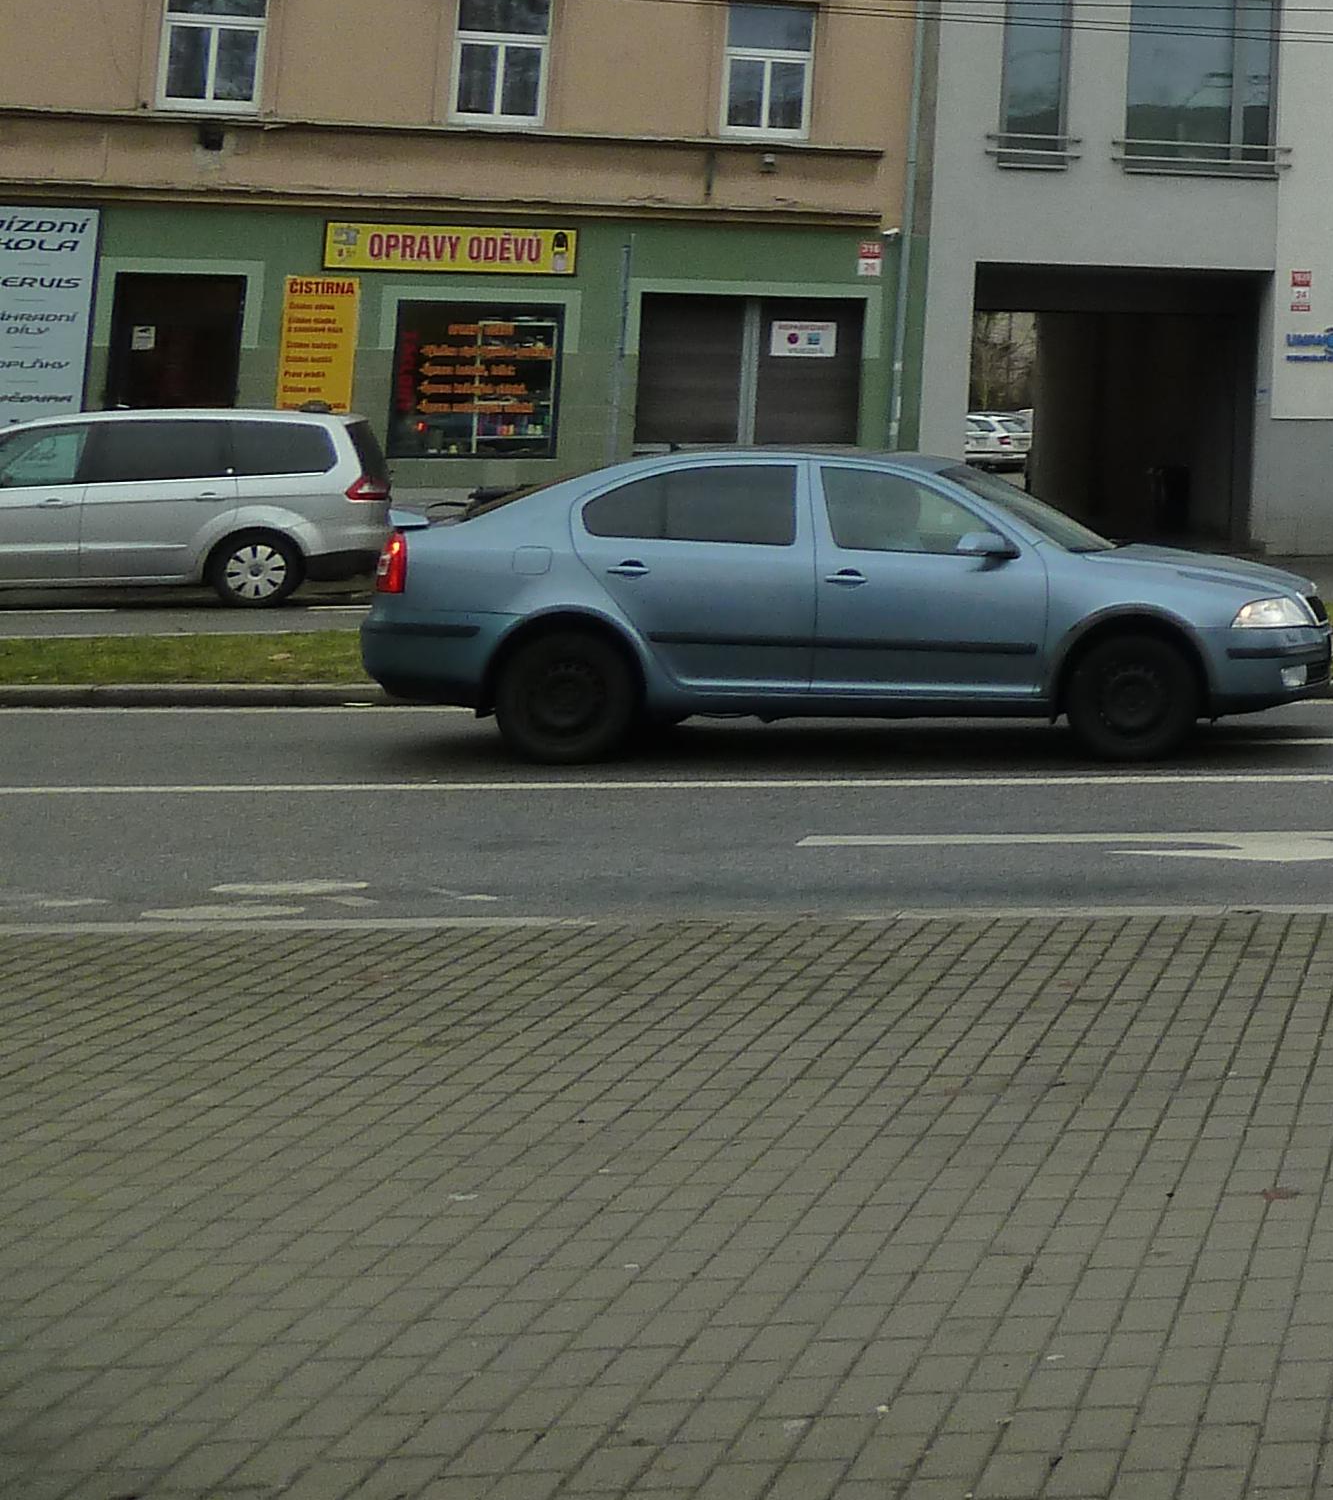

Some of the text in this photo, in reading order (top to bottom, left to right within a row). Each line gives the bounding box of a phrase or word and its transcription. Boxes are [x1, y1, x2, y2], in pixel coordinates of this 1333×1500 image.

[368, 231, 542, 263] OPRAVY ODĚVŮ
[0, 275, 83, 289] ERVIS
[289, 278, 354, 295] ČISTÍRNA
[0, 311, 79, 323] ÁHRADNÍ
[6, 325, 51, 335] DÍLY
